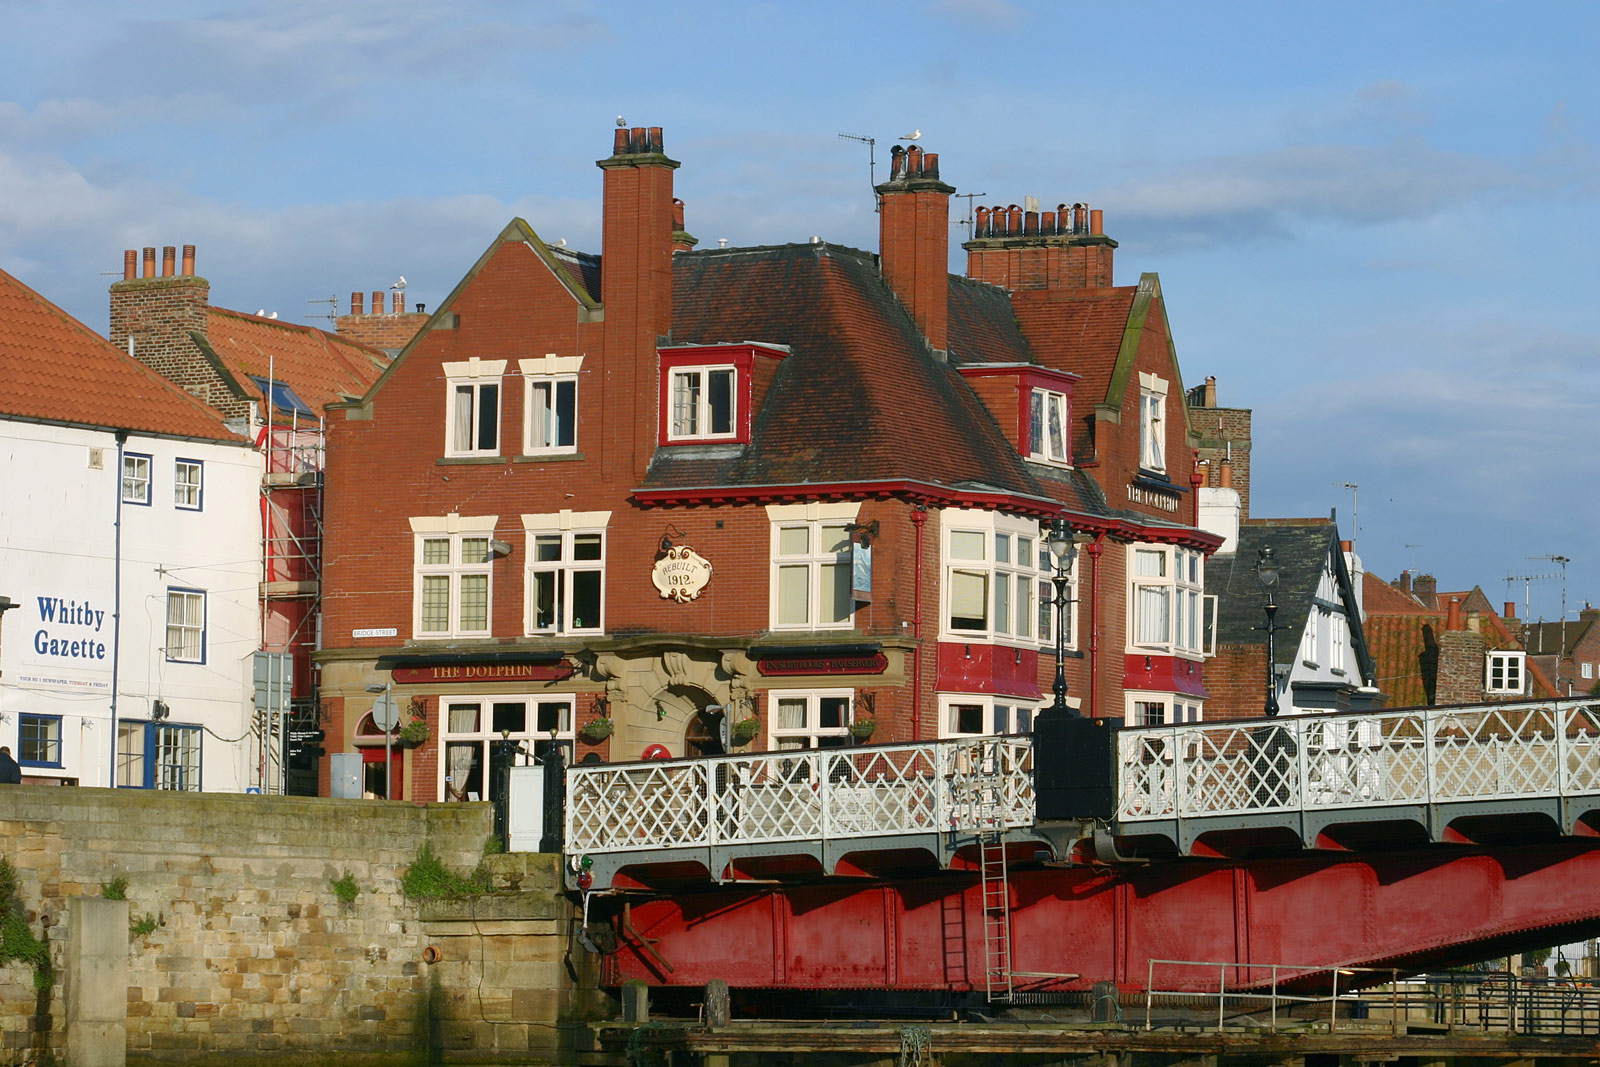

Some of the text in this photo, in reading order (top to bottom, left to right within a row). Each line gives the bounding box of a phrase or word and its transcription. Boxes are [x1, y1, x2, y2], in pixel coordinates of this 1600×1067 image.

[1126, 483, 1144, 504] THE
[662, 562, 698, 575] REBUILT
[37, 596, 104, 632] Whitby
[34, 629, 105, 660] Gazette
[430, 665, 532, 678] THE DOLPHIN
[800, 660, 825, 669] ROOMS
[831, 659, 847, 667] BAR
